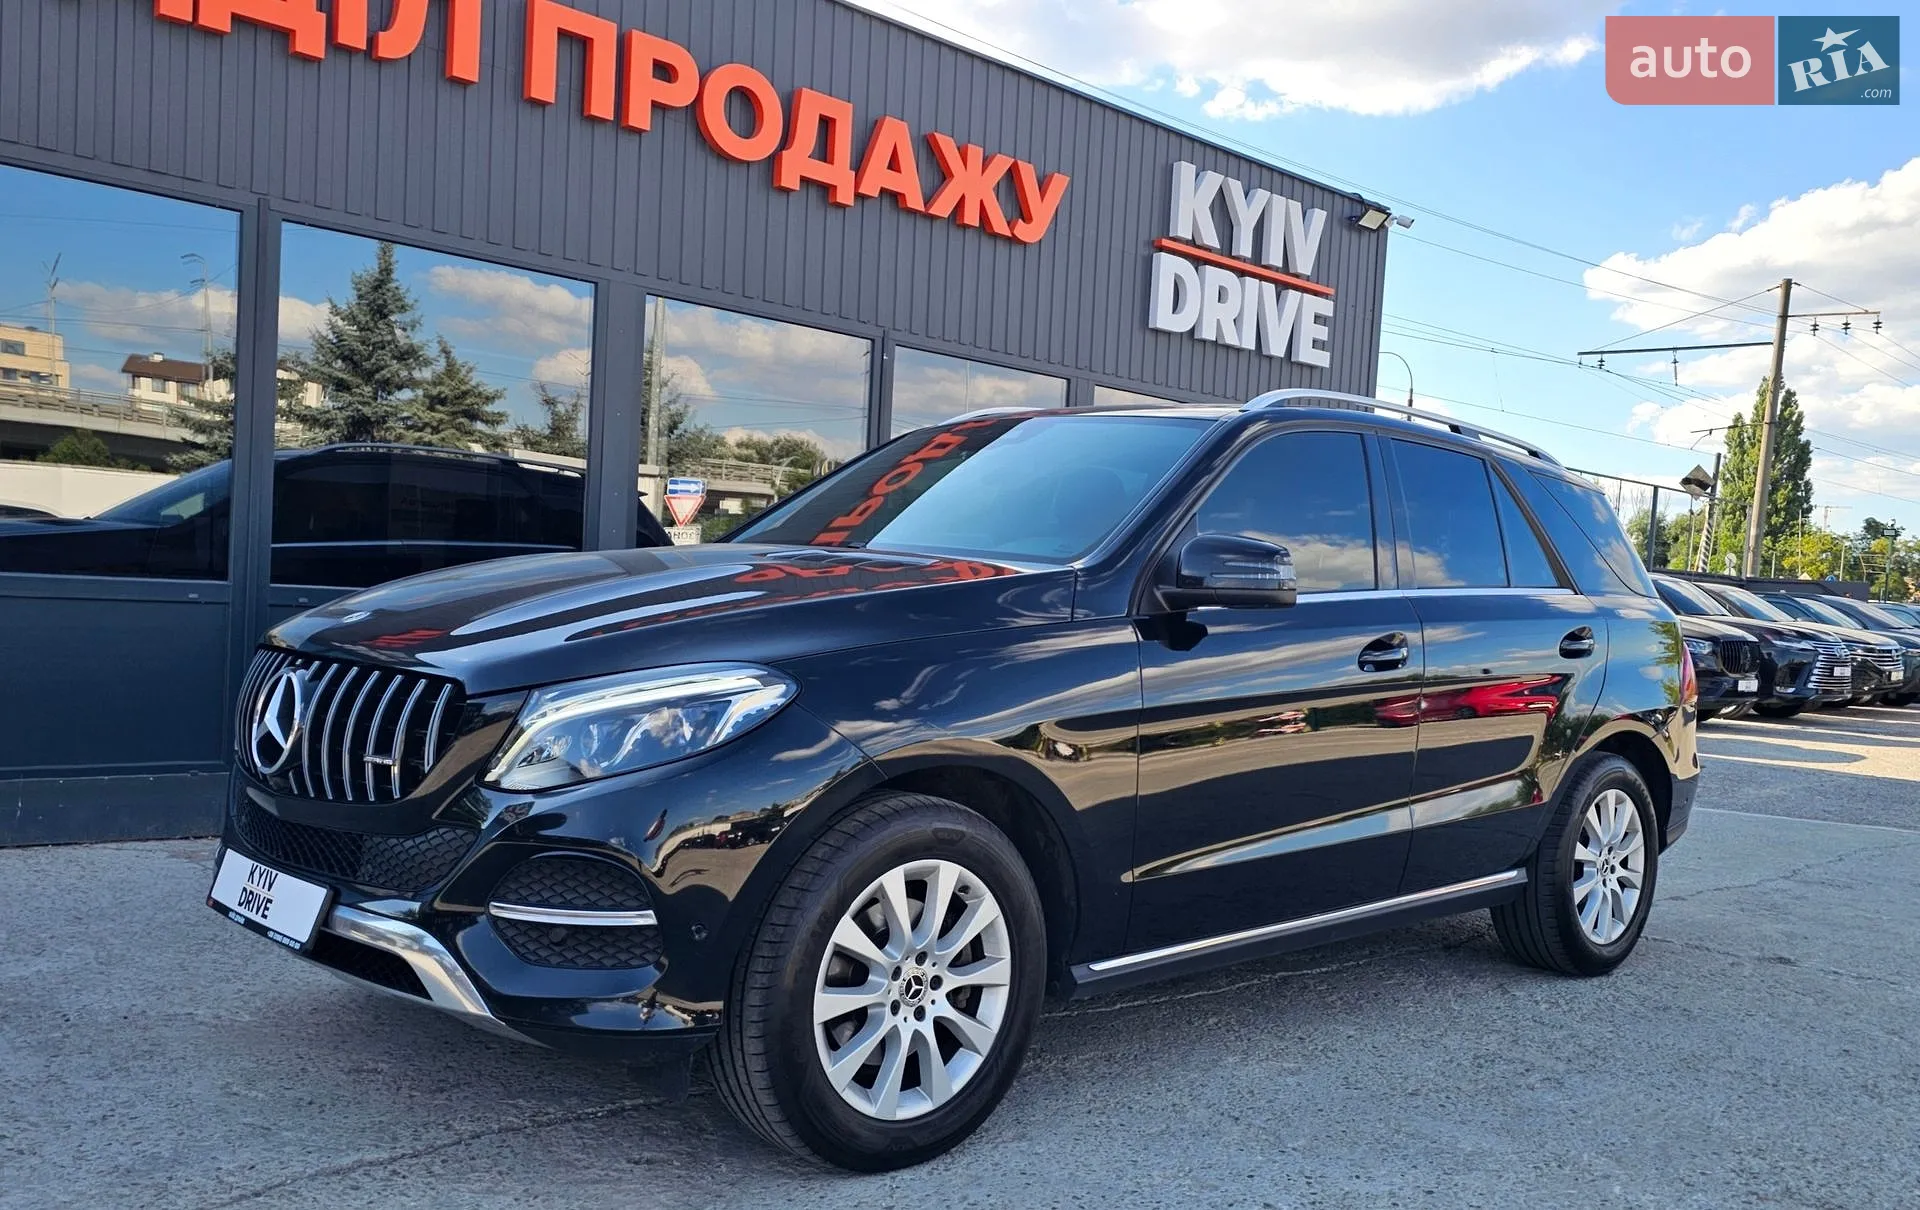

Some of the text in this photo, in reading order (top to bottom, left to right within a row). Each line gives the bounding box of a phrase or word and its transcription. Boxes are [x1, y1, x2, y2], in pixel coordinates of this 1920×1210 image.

[523, 0, 1070, 245] ПРОДАЖУ
[1169, 160, 1328, 277] KYIV
[1149, 251, 1334, 369] DRIVE
[237, 886, 274, 920] DRIVE
[247, 863, 279, 893] KYIV
